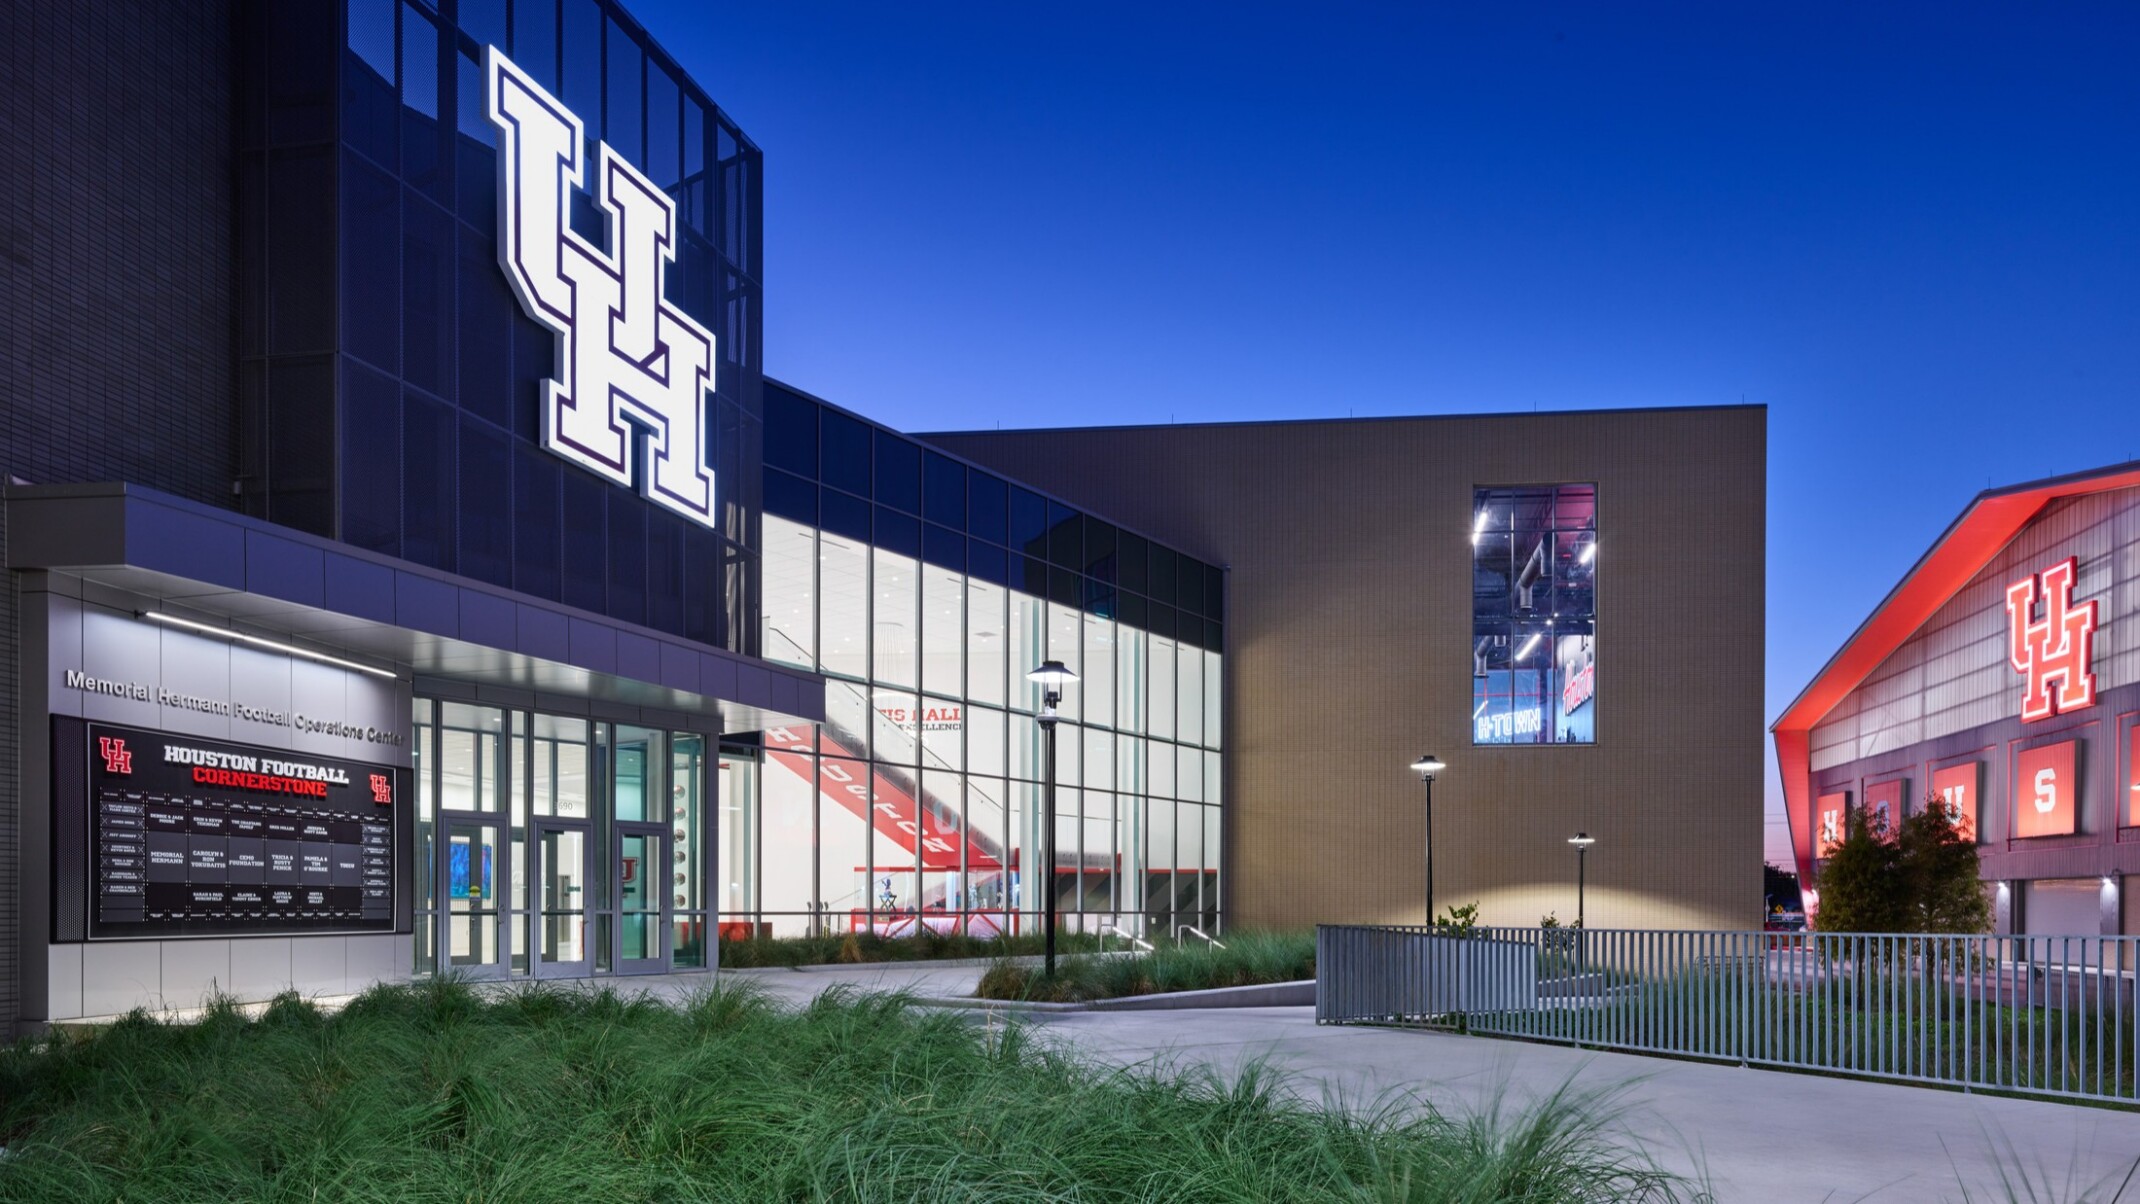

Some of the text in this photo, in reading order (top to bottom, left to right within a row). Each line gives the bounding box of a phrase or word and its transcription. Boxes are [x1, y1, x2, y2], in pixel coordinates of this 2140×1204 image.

[482, 44, 717, 528] UH
[2006, 556, 2098, 724] UH
[66, 669, 405, 748] Memorial Hermann Football Operations Center
[99, 737, 132, 774] UH
[164, 745, 350, 785] HOUSTON FOOTBALL
[192, 766, 328, 797] CORNERSTONE
[369, 774, 391, 804] UH
